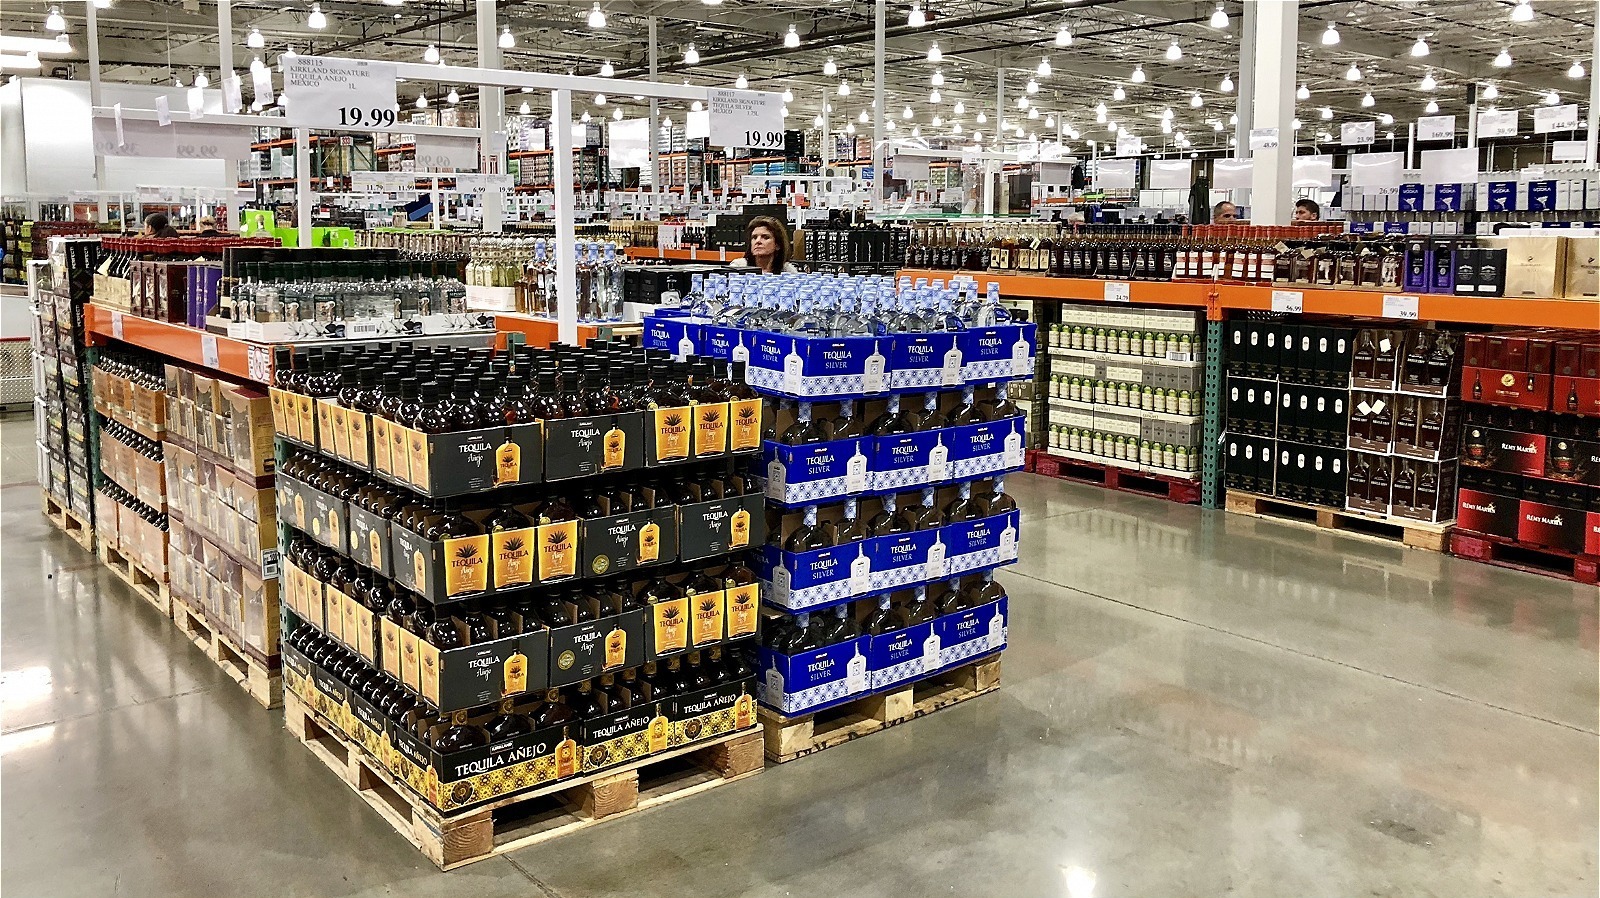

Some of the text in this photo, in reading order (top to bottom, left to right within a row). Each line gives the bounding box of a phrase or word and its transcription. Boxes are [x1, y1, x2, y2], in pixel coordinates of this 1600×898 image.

[298, 58, 323, 67] 888115
[290, 66, 370, 78] KIRKLAND SIGNATURE
[290, 73, 348, 83] TEQUILA ANEJO
[290, 79, 320, 87] MEXICO
[712, 96, 765, 106] KIRKLAND SIGNATURE
[338, 107, 395, 128] 19.99
[744, 130, 783, 148] 19.99
[1379, 187, 1399, 195] 26.99
[650, 329, 670, 340] TEQUILA
[652, 339, 668, 348] SILVER
[711, 338, 730, 348] TEQUILA
[979, 338, 1003, 348] TEQUILA
[712, 347, 727, 355] SILVER
[760, 344, 781, 355] TEQUILA
[907, 345, 934, 354] TEQUILA
[980, 347, 999, 355] SILVER
[762, 354, 778, 363] SILVER
[823, 350, 852, 361] TEQUILA
[909, 355, 930, 363] SILVER
[825, 361, 848, 369] SILVER
[699, 422, 724, 431] TEQUILA
[735, 417, 758, 427] TEQUILA
[570, 428, 601, 439] TEQUILA
[660, 426, 687, 435] TEQUILA
[969, 433, 994, 444] TEQUILA
[458, 442, 492, 453] TEQUILA
[891, 444, 918, 456] TEQUILA
[972, 443, 991, 452] SILVER
[806, 454, 835, 467] TEQUILA
[893, 455, 914, 464] SILVER
[808, 465, 831, 475] SILVER
[702, 510, 729, 521] TEQUILA
[607, 523, 636, 536] TEQUILA
[967, 528, 991, 539] TEQUILA
[543, 542, 573, 553] TEQUILA
[968, 538, 987, 548] SILVER
[890, 543, 917, 555] TEQUILA
[499, 550, 529, 561] TEQUILA
[892, 554, 913, 563] SILVER
[451, 557, 483, 568] TEQUILA
[809, 558, 838, 571] TEQUILA
[812, 569, 835, 580] SILVER
[731, 603, 755, 613] TEQUILA
[696, 610, 720, 621] TEQUILA
[659, 618, 684, 628] TEQUILA
[956, 618, 980, 631] TEQUILA
[573, 630, 602, 644] TEQUILA
[958, 627, 977, 638] SILVER
[888, 638, 913, 652] TEQUILA
[890, 648, 910, 661] SILVER
[467, 655, 501, 668] TEQUILA
[808, 659, 835, 672] TEQUILA
[810, 670, 832, 681] SILVER
[318, 678, 332, 692] TEQUILA
[683, 700, 712, 714] TEQUILA
[713, 694, 737, 707] AÑEJO
[356, 706, 371, 723] TEQUILA
[593, 725, 623, 739] TEQUILA
[625, 716, 650, 730] AÑEJO
[455, 742, 547, 777] TEQUILA AÑEJO
